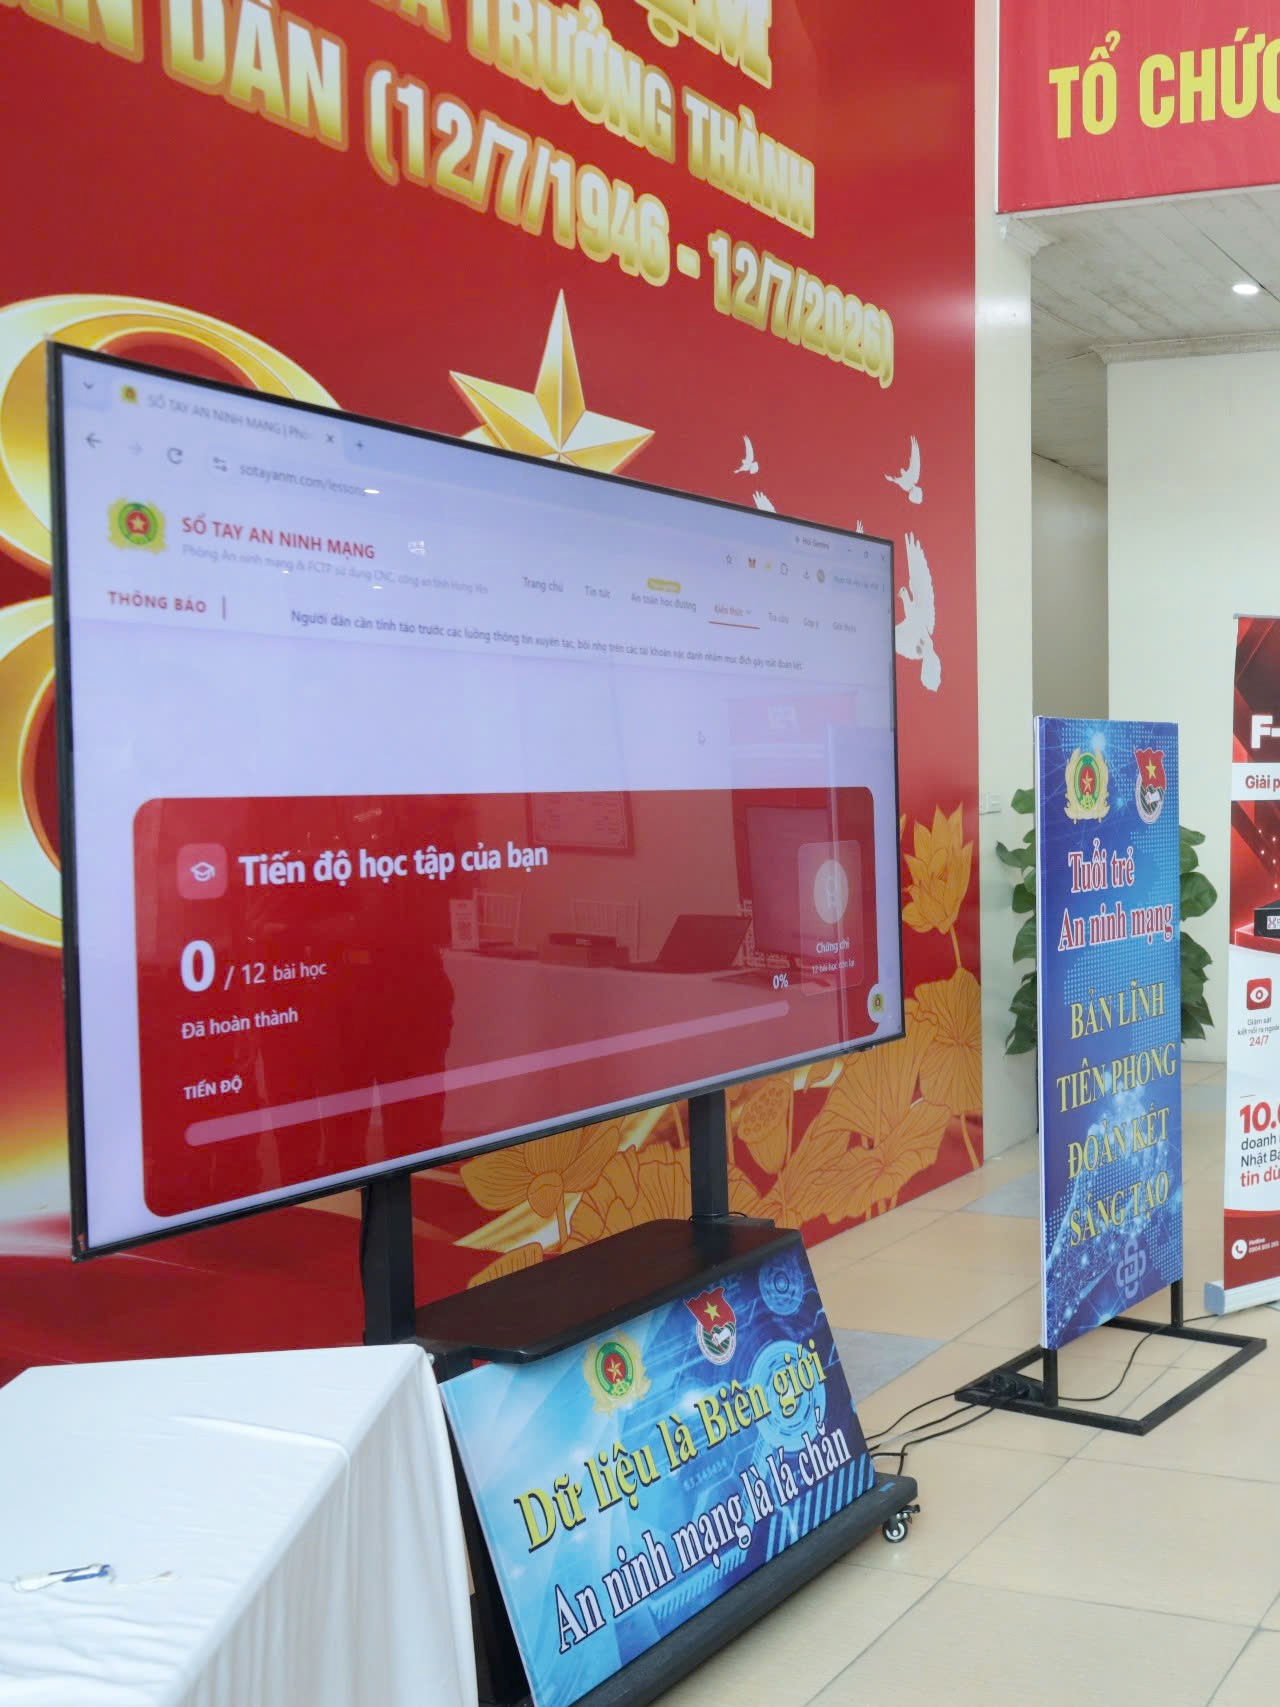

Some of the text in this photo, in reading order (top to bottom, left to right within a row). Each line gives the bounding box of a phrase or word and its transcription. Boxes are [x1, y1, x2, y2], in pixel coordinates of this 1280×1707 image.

[1048, 29, 1121, 139] TỔ
[467, 0, 675, 164] TRƯỞNG
[682, 85, 815, 239] THÀNH
[162, 0, 349, 152] DÂN
[363, 60, 670, 286] (12/7/1946
[708, 229, 894, 389] 12/7/2026)
[212, 520, 244, 541] TAY
[248, 526, 274, 545] AN
[279, 530, 322, 552] NINH
[327, 538, 376, 561] MẠNG
[108, 590, 207, 613] THÔNG BÁO
[237, 840, 549, 887] Tiến độ học tập của bạn
[1068, 837, 1135, 893] Tuổi trẻ
[1058, 901, 1173, 951] An ninh mạng
[180, 939, 216, 993] 0
[241, 962, 266, 985] 12
[273, 962, 296, 982] bài
[300, 961, 328, 981] học
[772, 972, 789, 991] 0%
[181, 1007, 299, 1040] Đã hoàn thành
[1070, 979, 1166, 1040] BẢN LĨNH
[1249, 1034, 1269, 1047] 24/7
[183, 1074, 243, 1101] TIẾN ĐỘ
[1056, 1040, 1177, 1114] TIÊN PHONG
[1131, 1100, 1170, 1153] KẾT
[1241, 1132, 1277, 1151] doanh
[1240, 1152, 1268, 1168] Nhật
[1240, 1170, 1260, 1188] tin
[1069, 1169, 1170, 1249] SÁNG TẠO
[513, 1472, 586, 1553] Dữ
[583, 1441, 661, 1512] liệu
[655, 1412, 699, 1474] là
[693, 1379, 773, 1448] Biên
[773, 1337, 828, 1416] giới
[553, 1582, 607, 1655] An
[601, 1529, 675, 1620] ninh
[671, 1502, 753, 1569] mạng
[739, 1460, 775, 1526] là
[766, 1444, 800, 1509] lá
[798, 1407, 853, 1489] chắn
